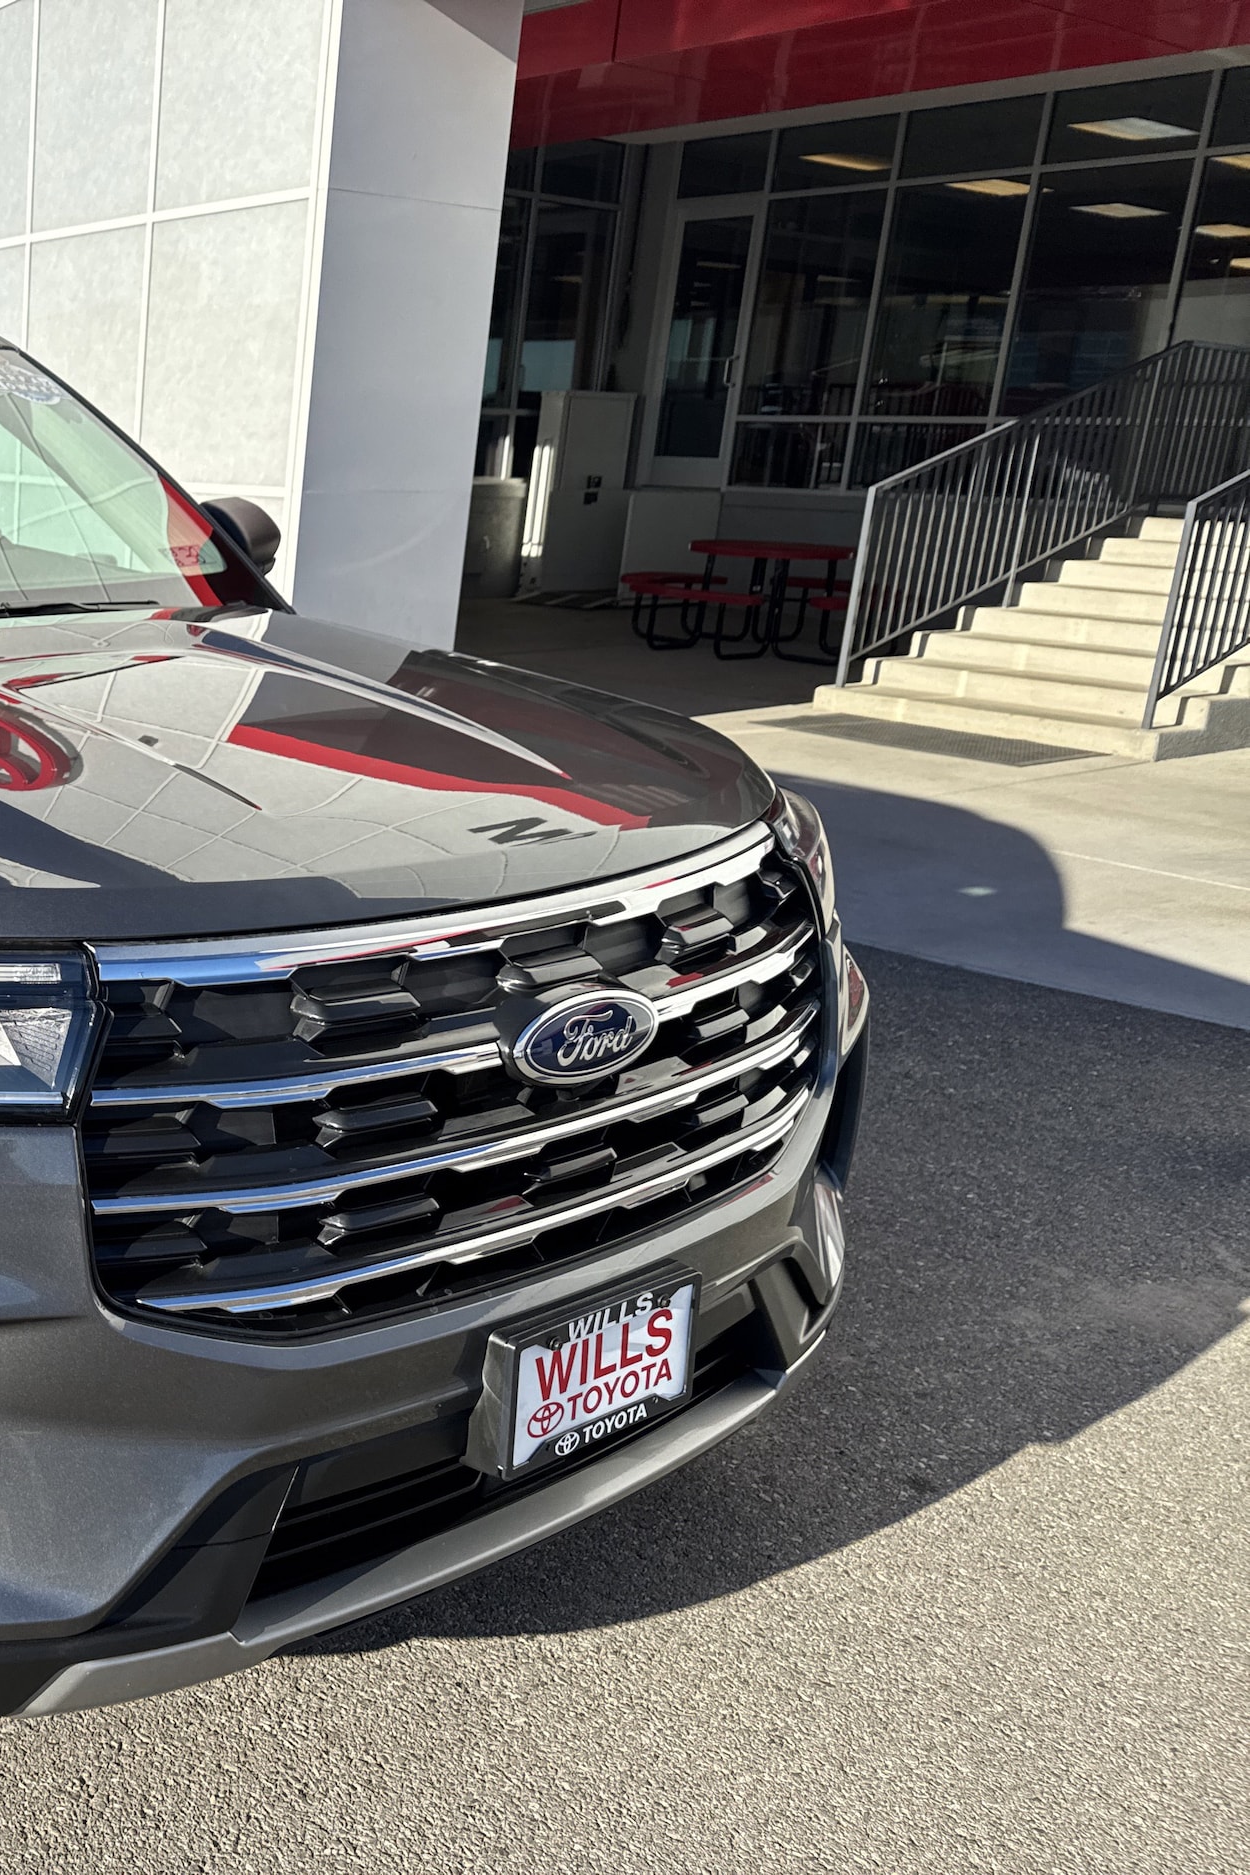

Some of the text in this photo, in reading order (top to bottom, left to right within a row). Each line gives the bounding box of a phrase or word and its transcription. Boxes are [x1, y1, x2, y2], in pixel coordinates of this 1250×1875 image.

[557, 1009, 633, 1067] Ford
[568, 1292, 654, 1342] WILLS
[535, 1308, 673, 1402] WILLS
[567, 1358, 672, 1421] TOYOTA
[582, 1403, 648, 1444] TOYOTA
